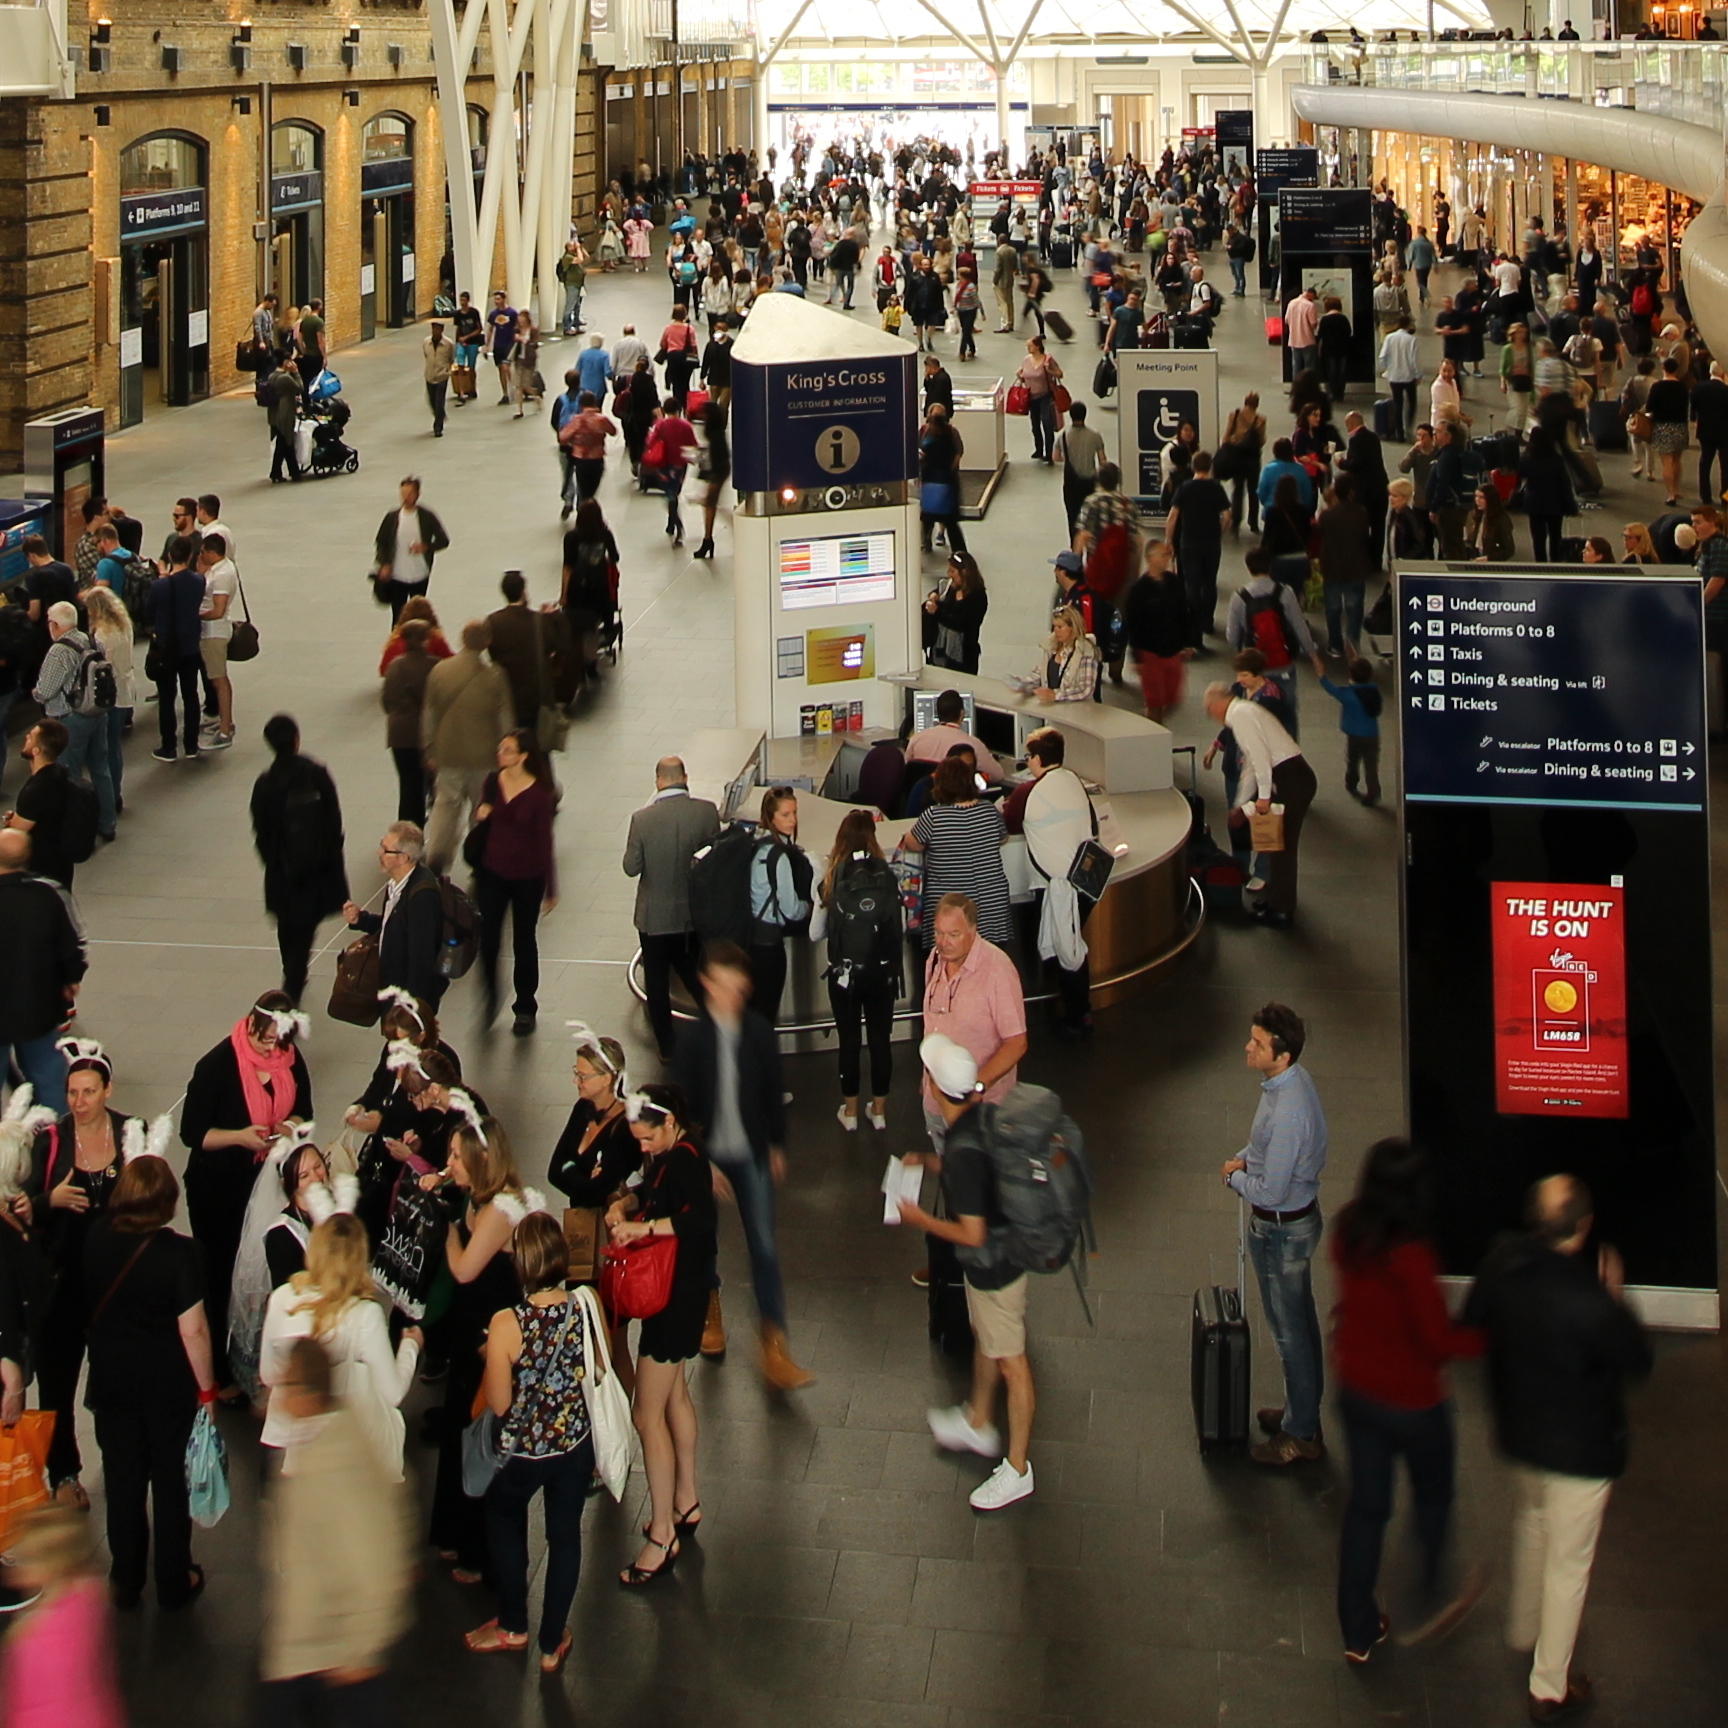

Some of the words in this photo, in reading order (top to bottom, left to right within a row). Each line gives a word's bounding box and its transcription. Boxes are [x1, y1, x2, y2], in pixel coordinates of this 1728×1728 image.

[145, 206, 171, 219] Platforms
[184, 201, 193, 213] and
[1136, 363, 1173, 373] Meeting
[1174, 362, 1198, 371] Point
[787, 372, 836, 392] King's
[838, 369, 886, 386] Cross
[787, 399, 830, 409] CUSTOMER
[833, 396, 886, 406] INFORMATION
[1450, 598, 1537, 613] Underground
[1450, 622, 1514, 638] Platforms
[1516, 625, 1526, 637] 0
[1528, 626, 1543, 638] to
[1546, 625, 1556, 638] 8
[1450, 647, 1483, 660] Taxis
[1451, 672, 1494, 688] Dining
[1497, 674, 1508, 687] &
[1511, 674, 1559, 690] seating
[1451, 697, 1498, 711] Tickets
[1547, 738, 1611, 753] Platforms
[1613, 740, 1623, 753] 0
[1625, 741, 1641, 754] to
[1643, 741, 1653, 754] 8
[1544, 762, 1588, 779] Dining
[1590, 764, 1601, 778] &
[1604, 766, 1654, 782] seating
[1506, 898, 1547, 916] THE
[1552, 900, 1613, 919] HUNT
[1530, 919, 1549, 937] IS
[1553, 920, 1589, 938] ON
[1549, 947, 1574, 970] Virgin
